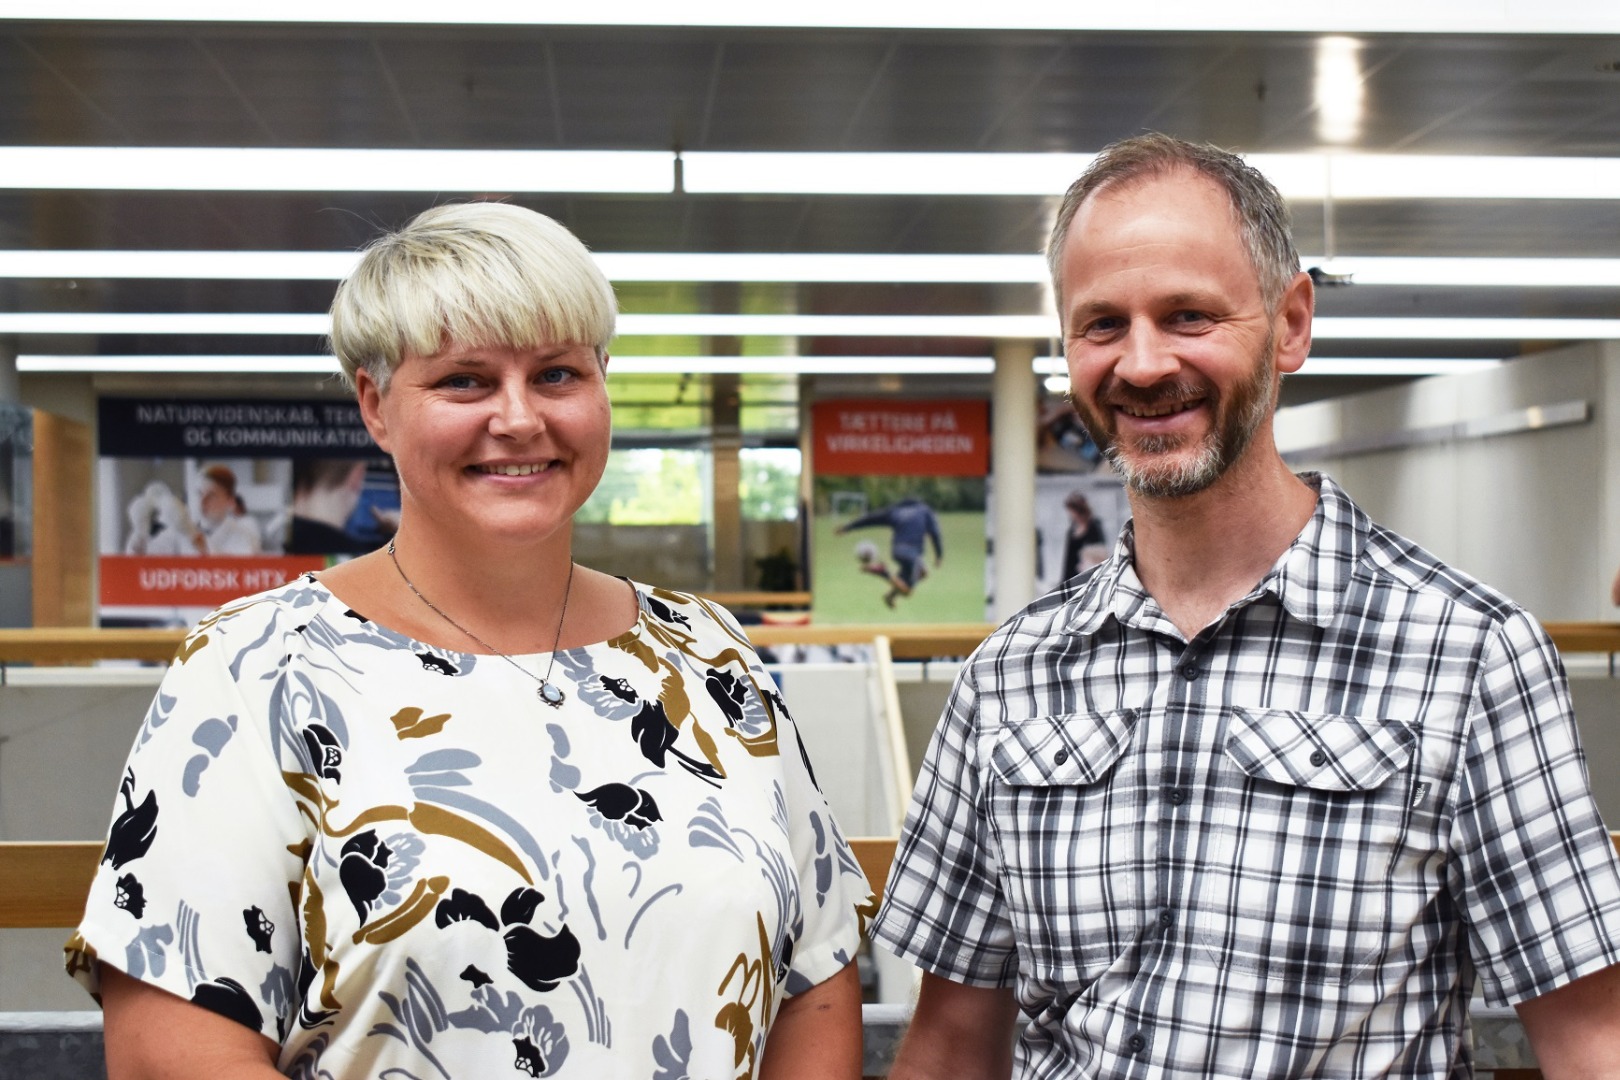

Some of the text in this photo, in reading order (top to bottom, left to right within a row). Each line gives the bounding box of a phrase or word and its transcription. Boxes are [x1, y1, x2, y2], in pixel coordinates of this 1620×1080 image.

[184, 427, 212, 446] OG
[825, 433, 974, 453] VIRKELIGHEDEN
[139, 568, 240, 590] UDFORSK
